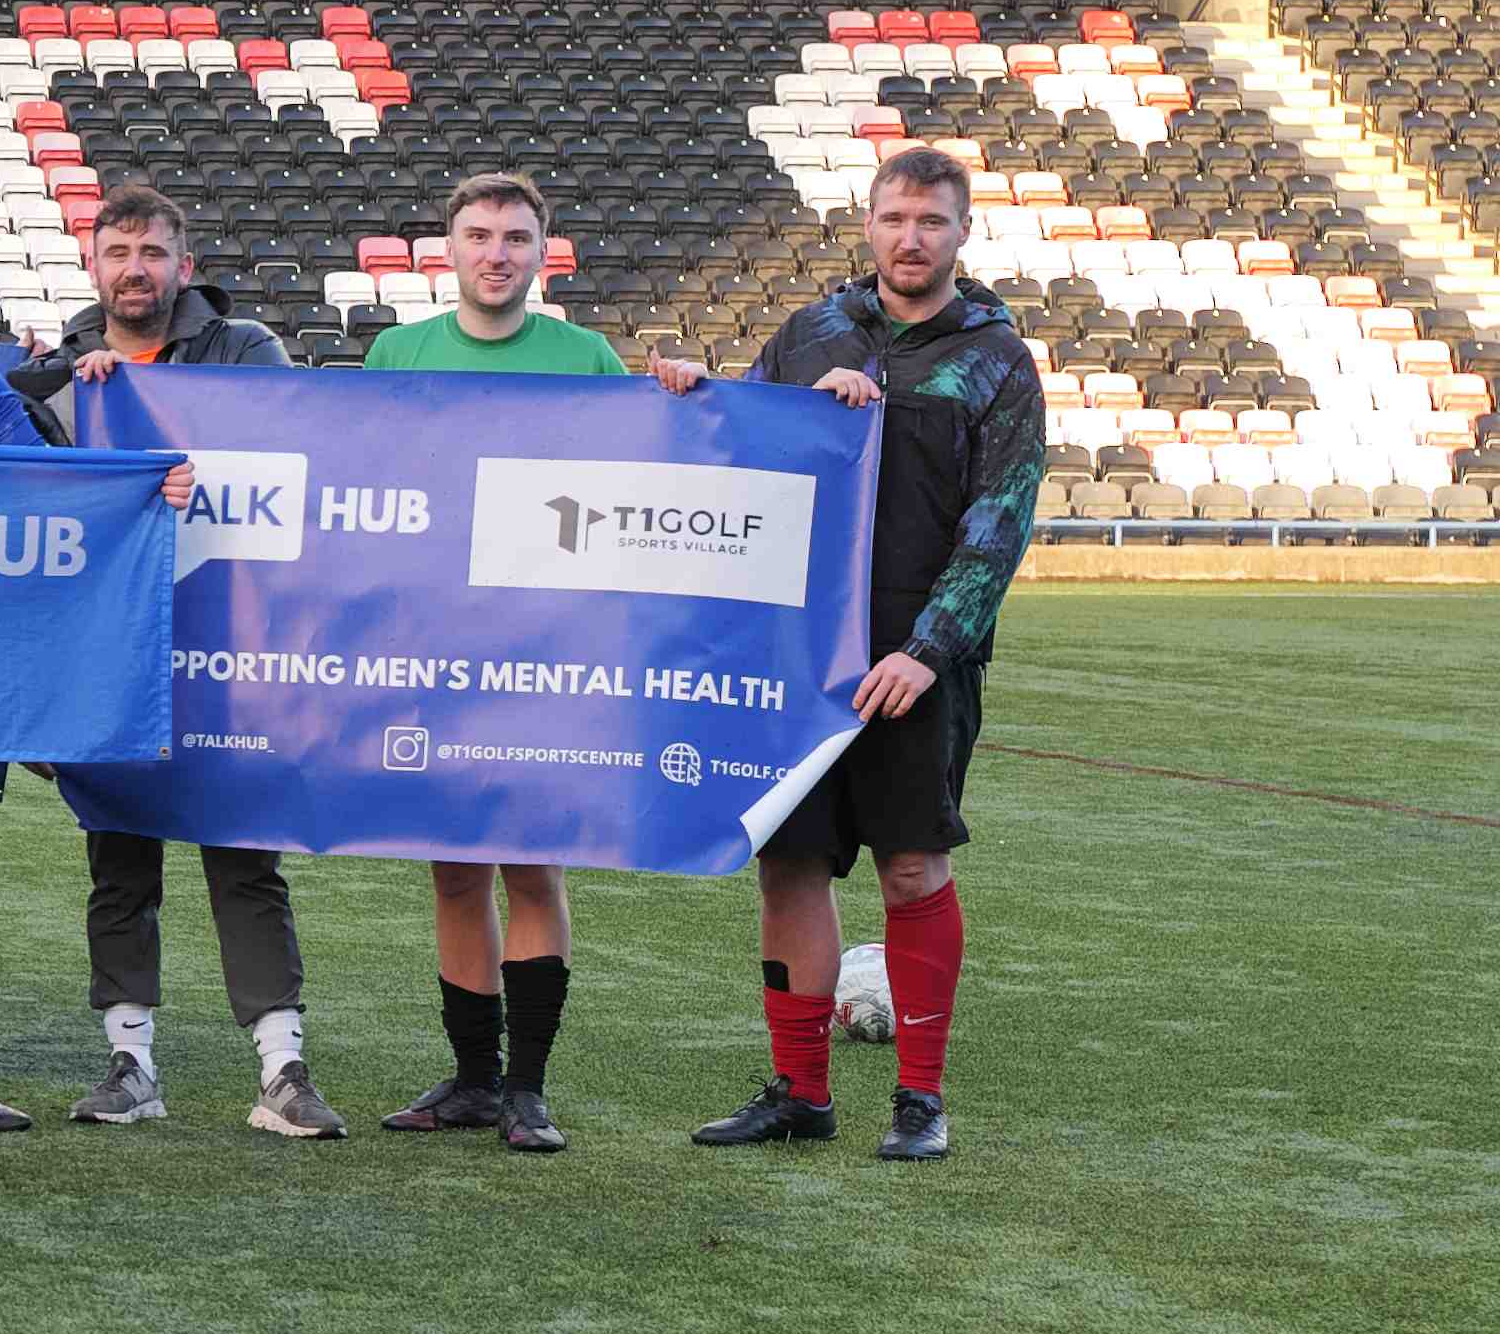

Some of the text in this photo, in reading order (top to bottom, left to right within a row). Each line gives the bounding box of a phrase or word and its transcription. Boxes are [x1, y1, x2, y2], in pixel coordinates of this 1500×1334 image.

[319, 486, 431, 534] HUB
[613, 505, 764, 540] T1GOLF
[619, 536, 749, 556] SPORTS VILLAGE
[354, 654, 785, 712] MEN'S MENTAL HEALTH
[437, 743, 644, 770] @T1GOLFSPORTSCENTRE
